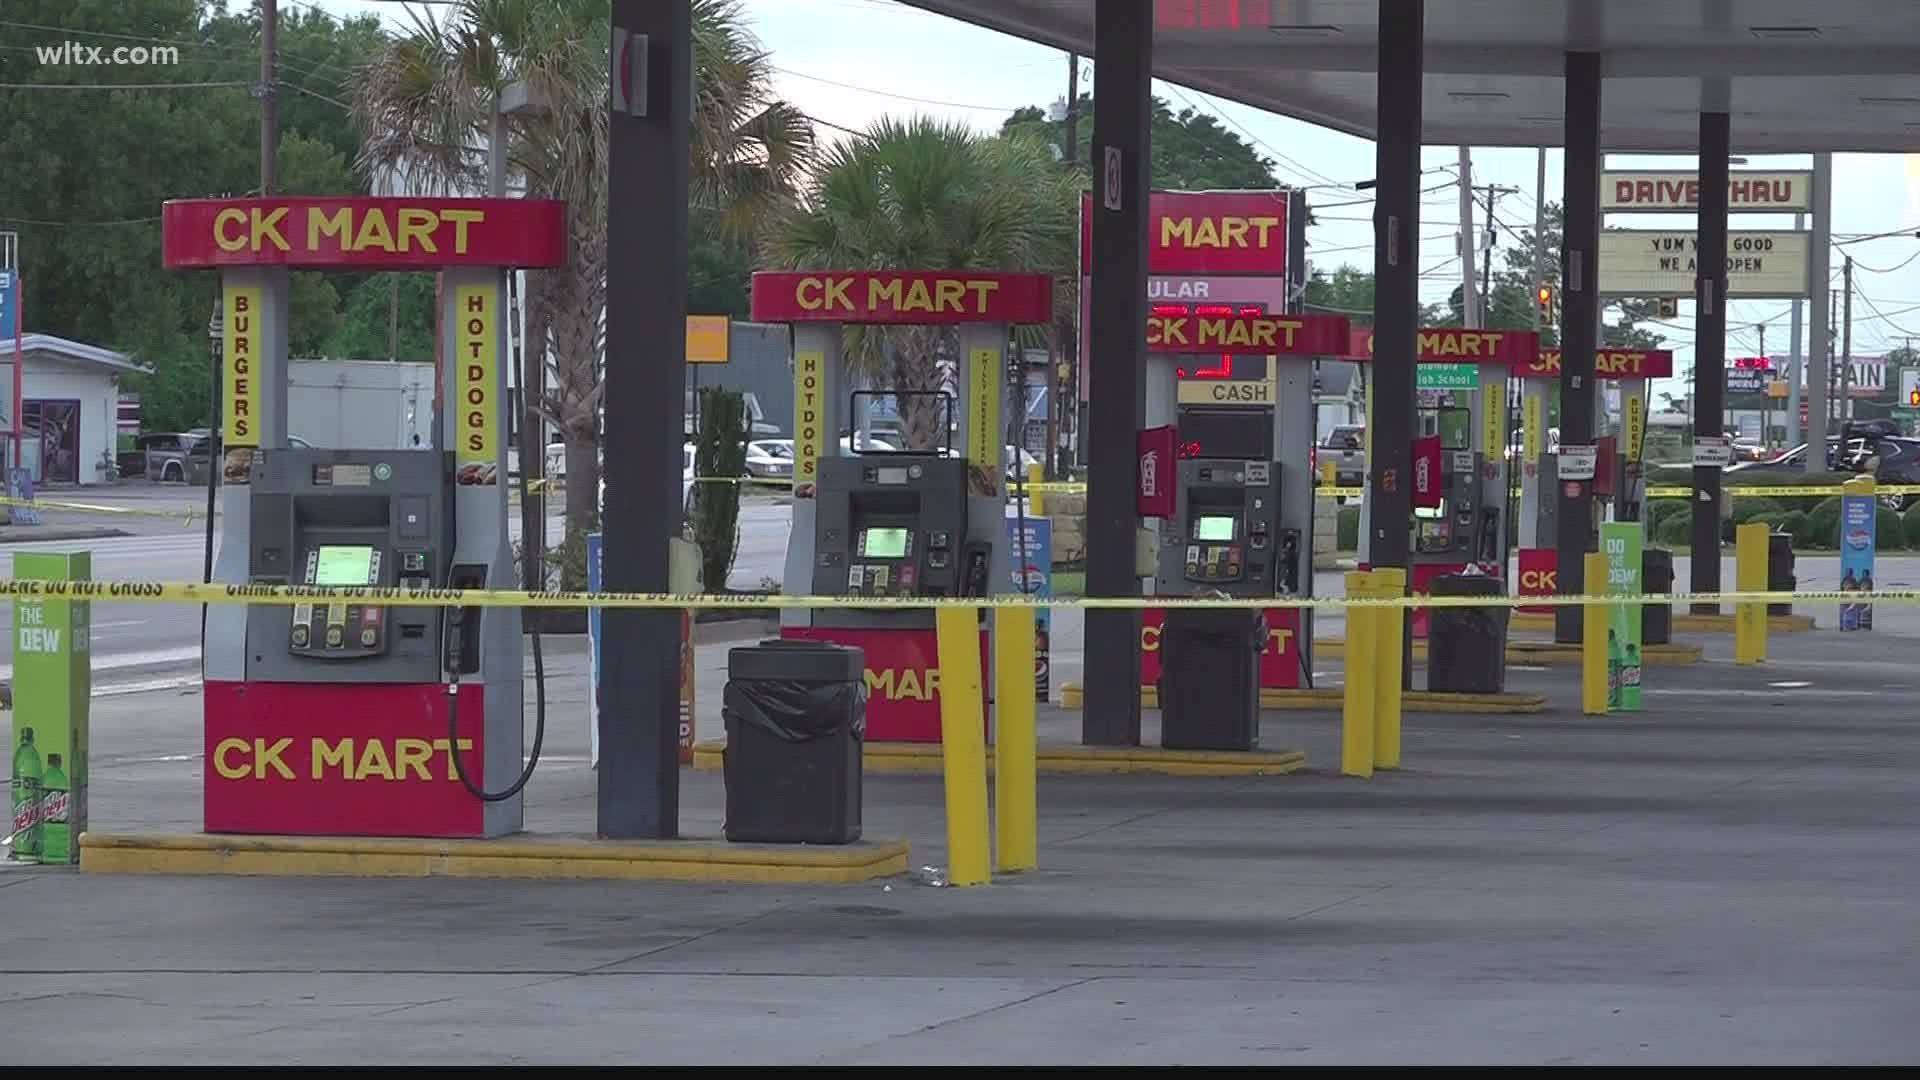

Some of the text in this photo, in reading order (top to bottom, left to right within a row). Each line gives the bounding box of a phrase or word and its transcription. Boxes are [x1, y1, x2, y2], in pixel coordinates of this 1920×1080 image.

[1616, 180, 1791, 202] DRIVE HRU
[213, 207, 485, 254] CK MART
[1160, 216, 1279, 249] MART
[1652, 238, 1684, 251] YUM
[1734, 238, 1773, 251] GOOD
[1659, 257, 1680, 271] WE
[1727, 257, 1762, 271] OPEN
[796, 277, 999, 313] CK MART
[1147, 281, 1209, 298] ULAR
[1146, 318, 1303, 347] CK MART
[1416, 333, 1502, 356] MART
[234, 295, 249, 437] BURGERS
[1595, 353, 1646, 373] ART
[1834, 363, 1880, 387] AIN
[1212, 384, 1268, 401] CASH
[1521, 571, 1557, 590] CK
[20, 607, 43, 625] THE
[19, 628, 61, 653] DEW
[863, 669, 942, 701] MAR
[213, 738, 473, 781] CK MART
